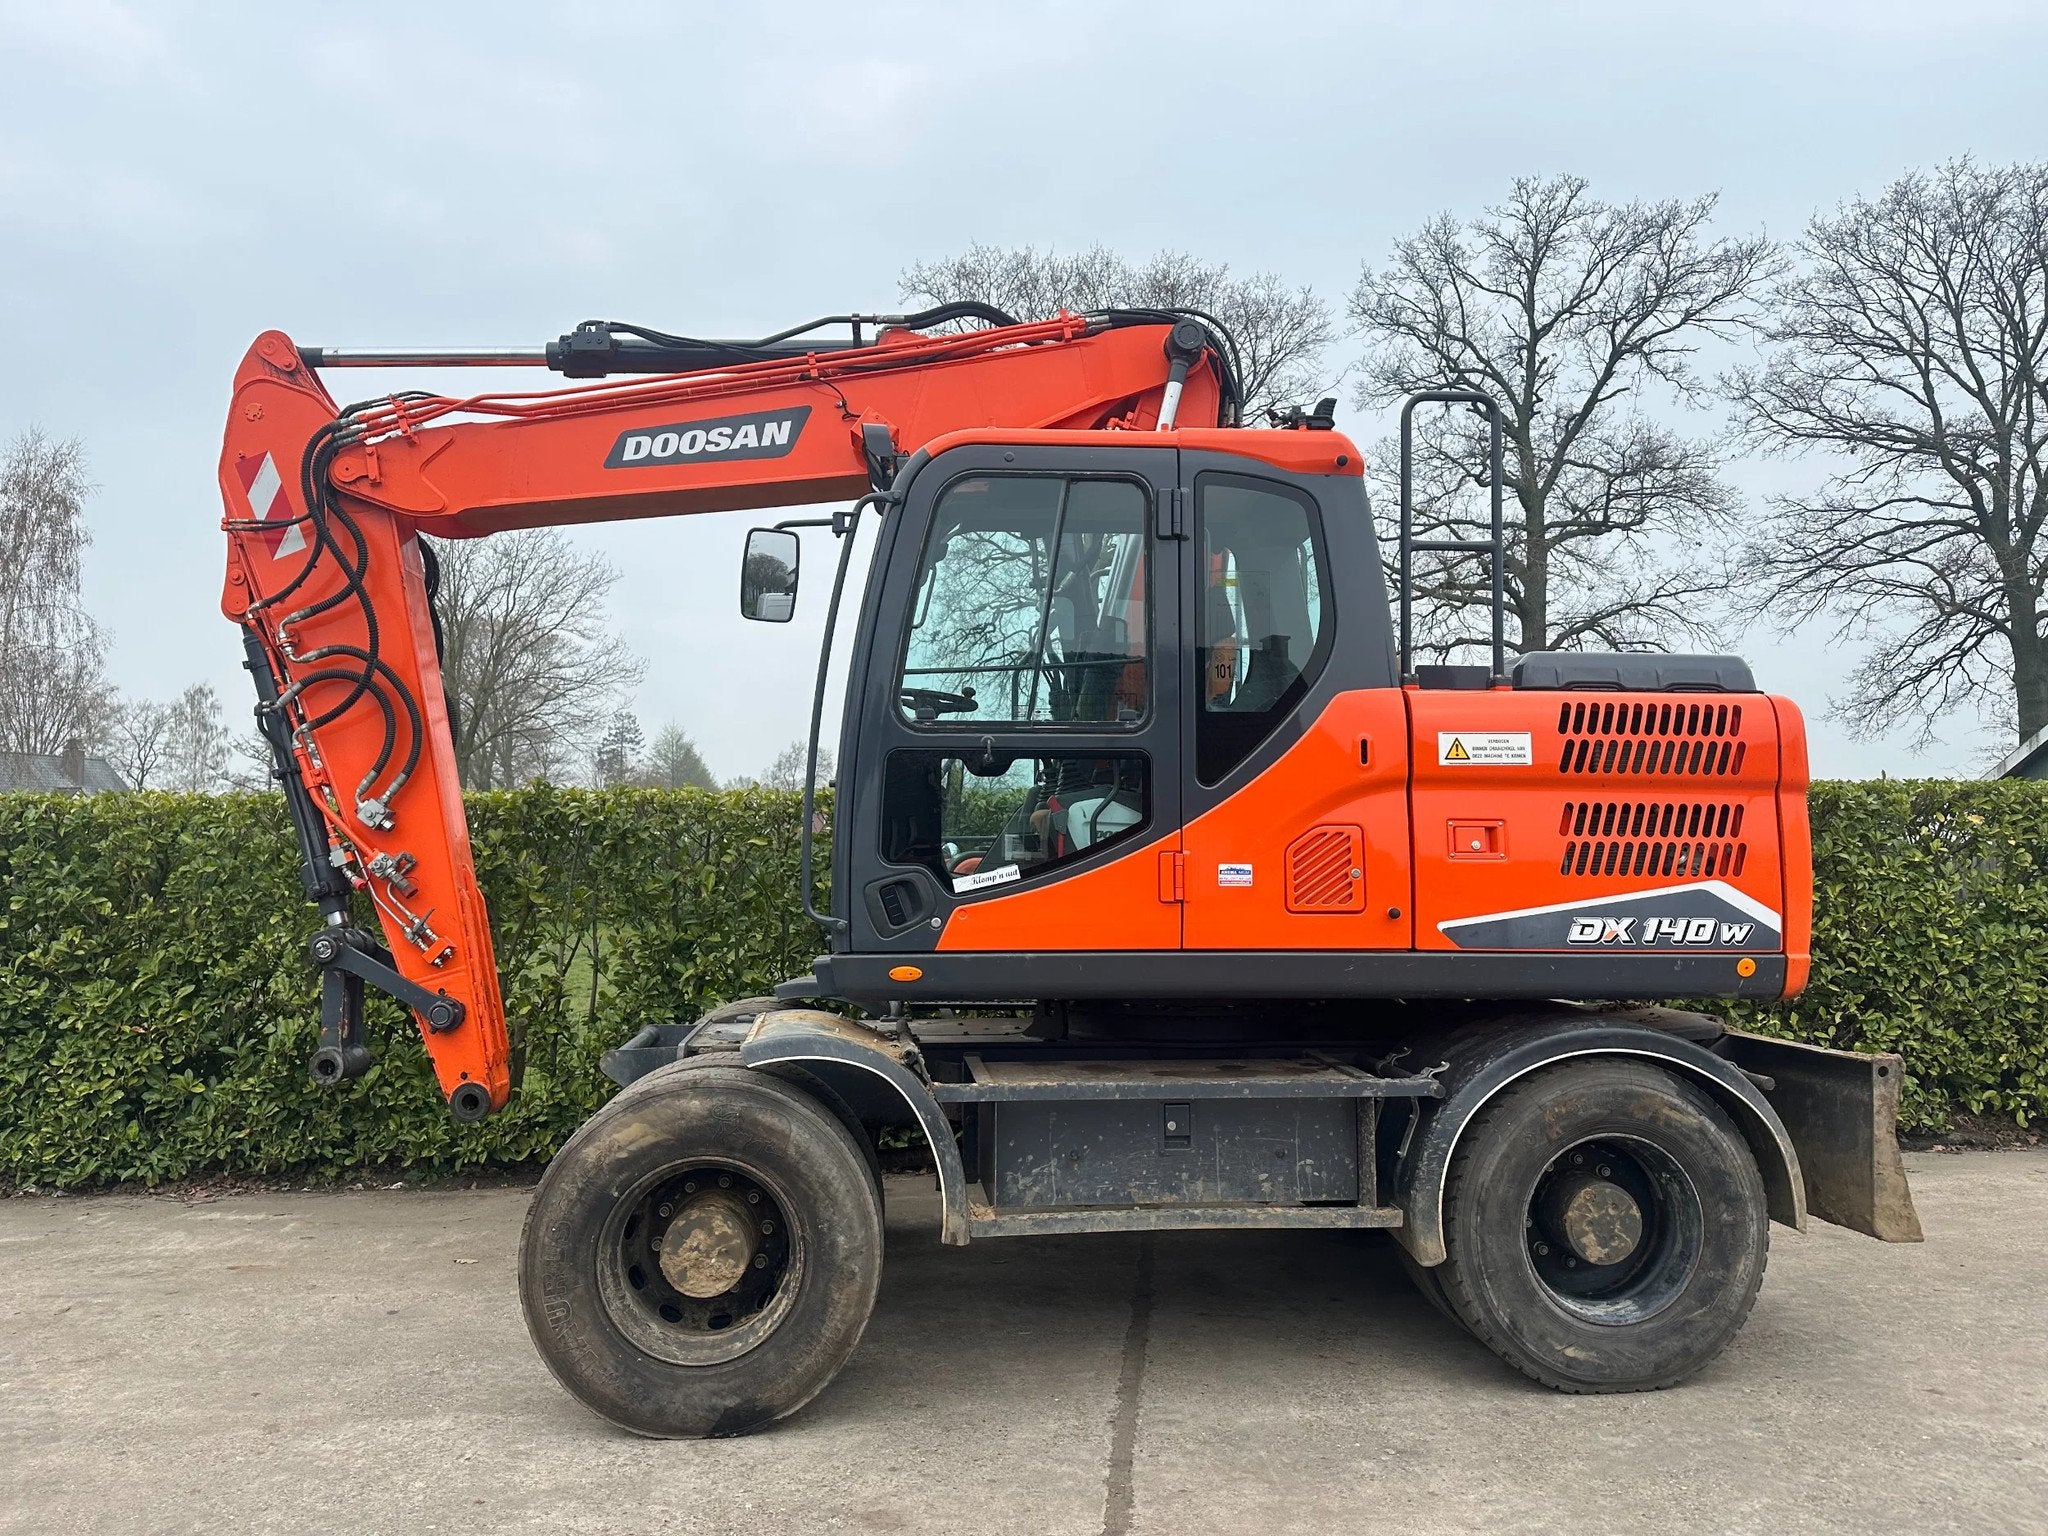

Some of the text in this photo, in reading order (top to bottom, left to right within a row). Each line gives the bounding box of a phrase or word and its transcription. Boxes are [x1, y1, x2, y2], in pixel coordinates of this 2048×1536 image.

[622, 420, 792, 461] DOOSAN
[1215, 664, 1232, 679] 101
[1567, 916, 1638, 946] DX
[1643, 917, 1718, 946] 140
